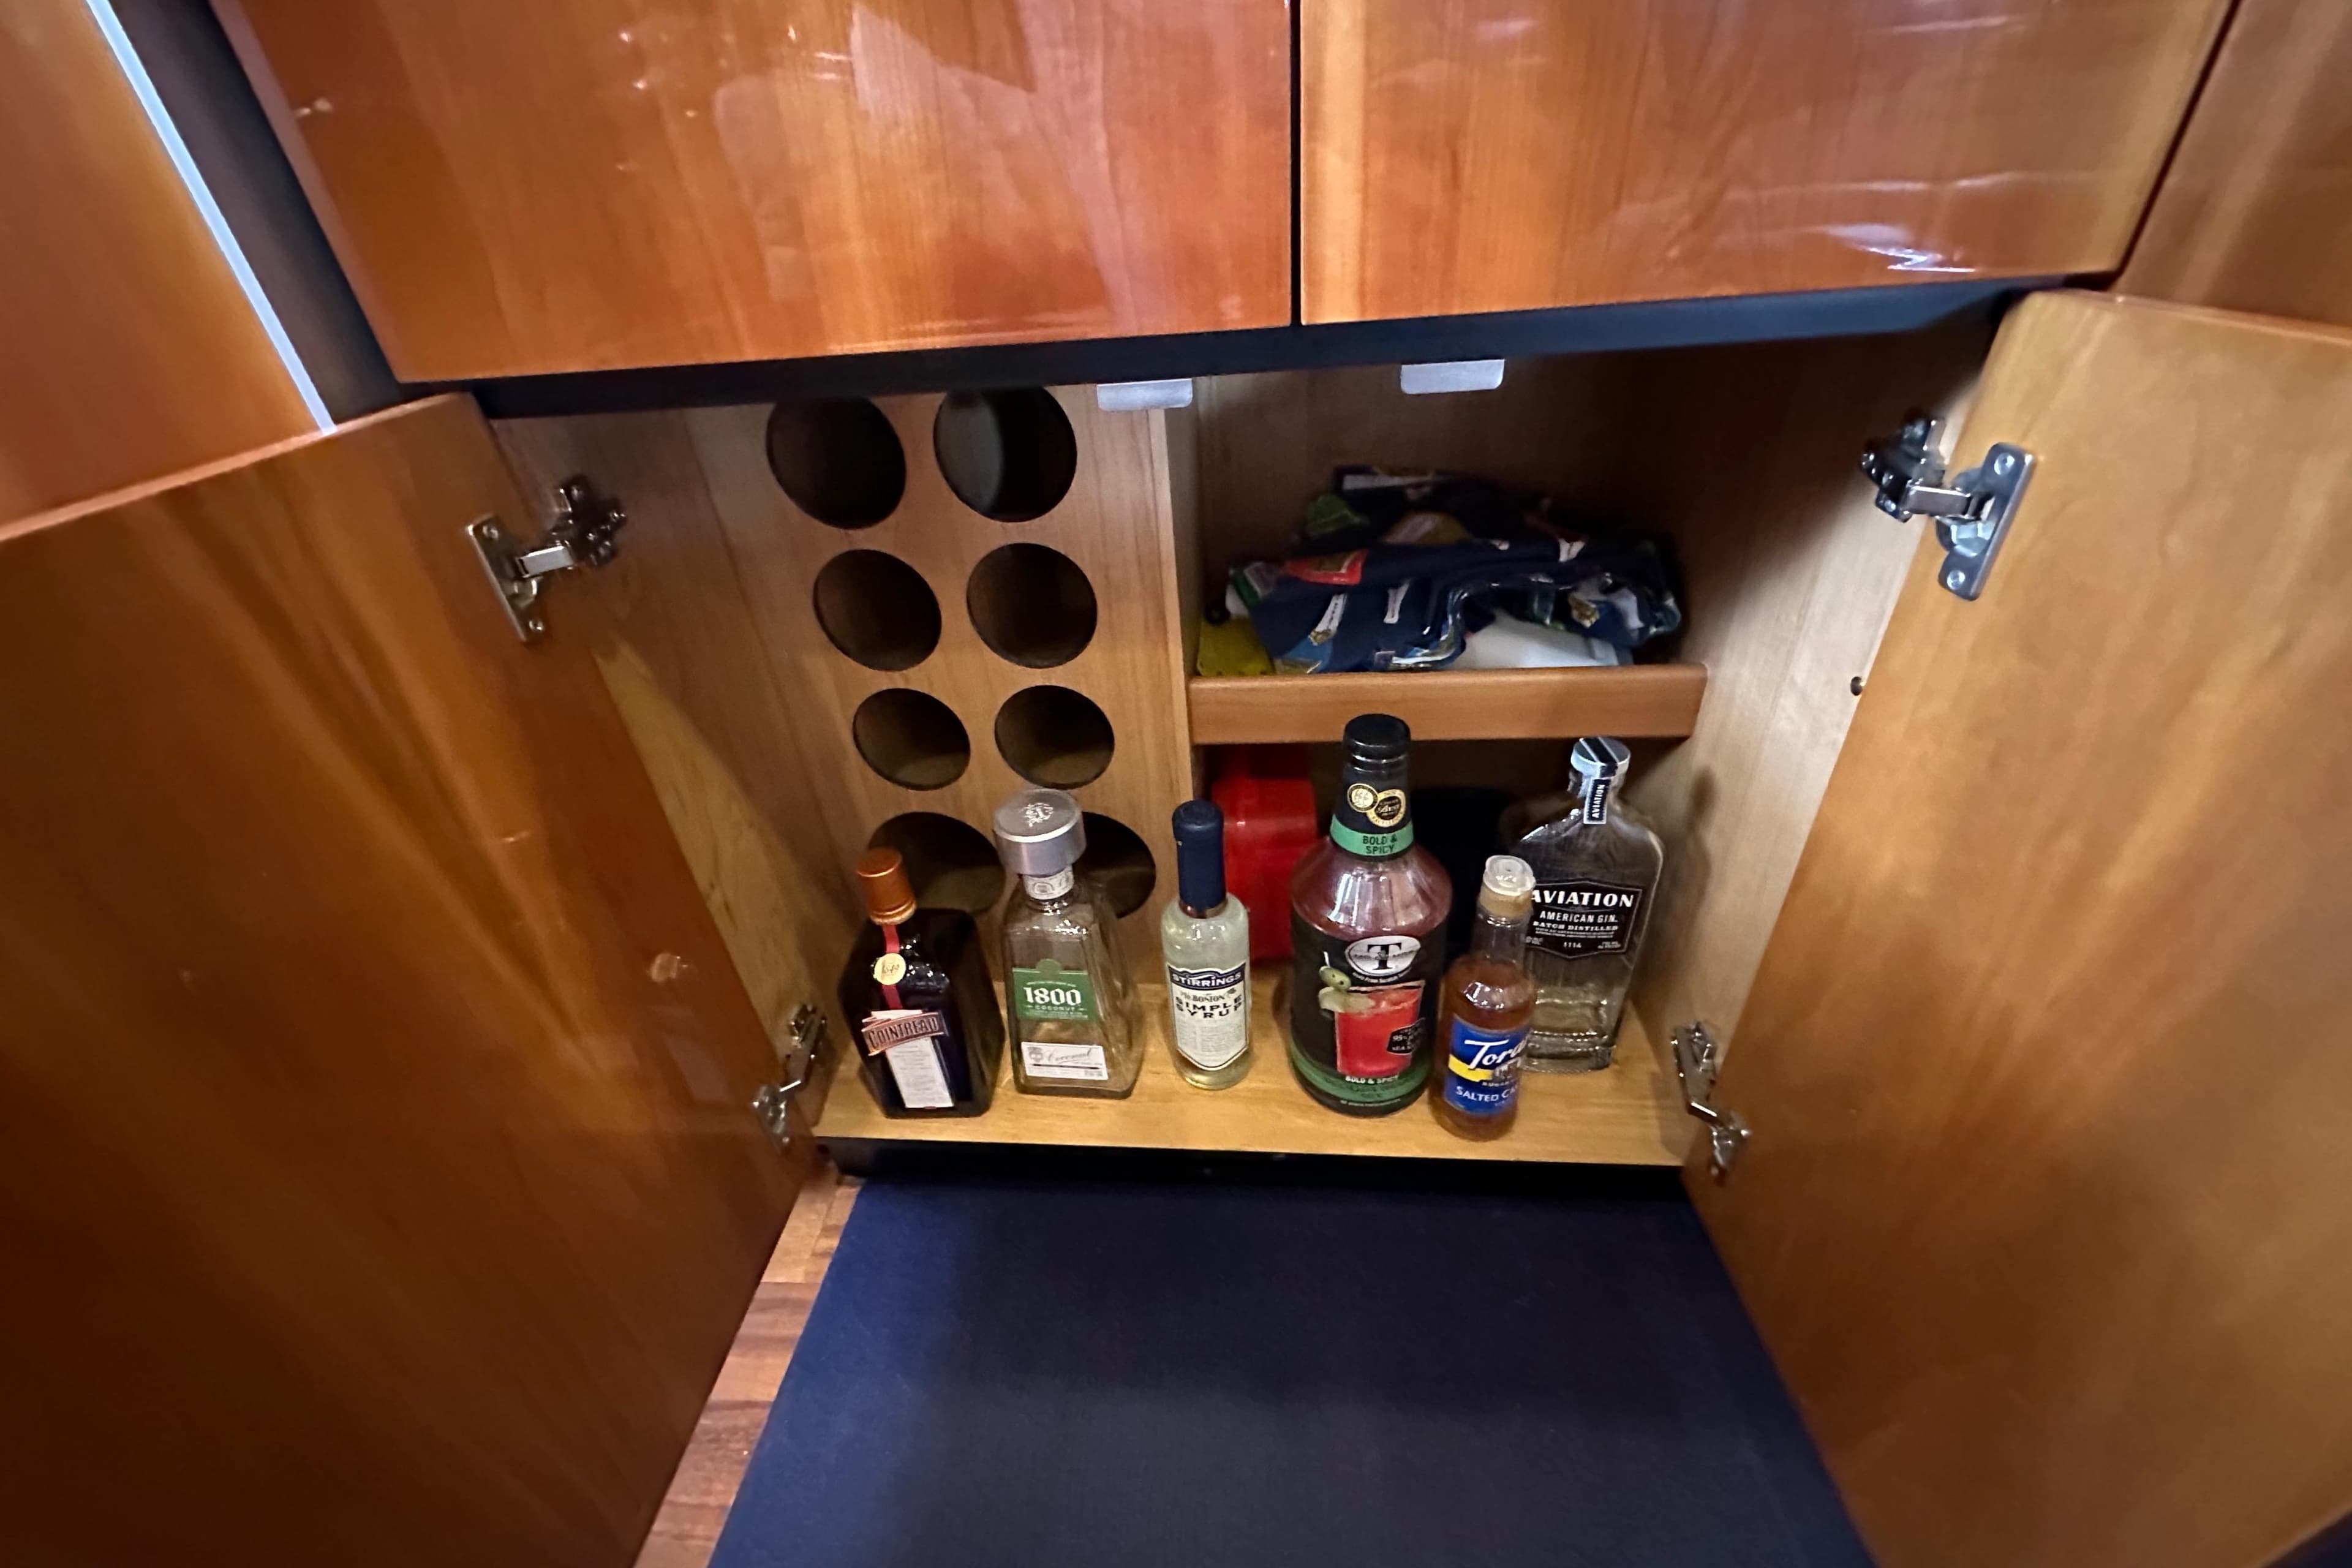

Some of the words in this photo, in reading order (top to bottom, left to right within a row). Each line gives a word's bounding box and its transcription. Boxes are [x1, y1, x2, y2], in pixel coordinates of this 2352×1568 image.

[1592, 784, 1605, 818] AVIATION
[1363, 835, 1388, 845] BOLD
[1390, 834, 1397, 843] &
[1366, 845, 1395, 854] SPICY
[1531, 889, 1634, 908] AVIATION
[1540, 910, 1595, 924] AMERICAN
[1532, 921, 1566, 930] BATCH
[1172, 971, 1242, 987] STIRRINGS
[1023, 987, 1082, 1006] 1800
[1175, 995, 1242, 1011] SIMPLE
[1176, 1001, 1242, 1019] SYRUP
[868, 1016, 939, 1050] COINTREAU
[1456, 1086, 1499, 1102] SALTED
